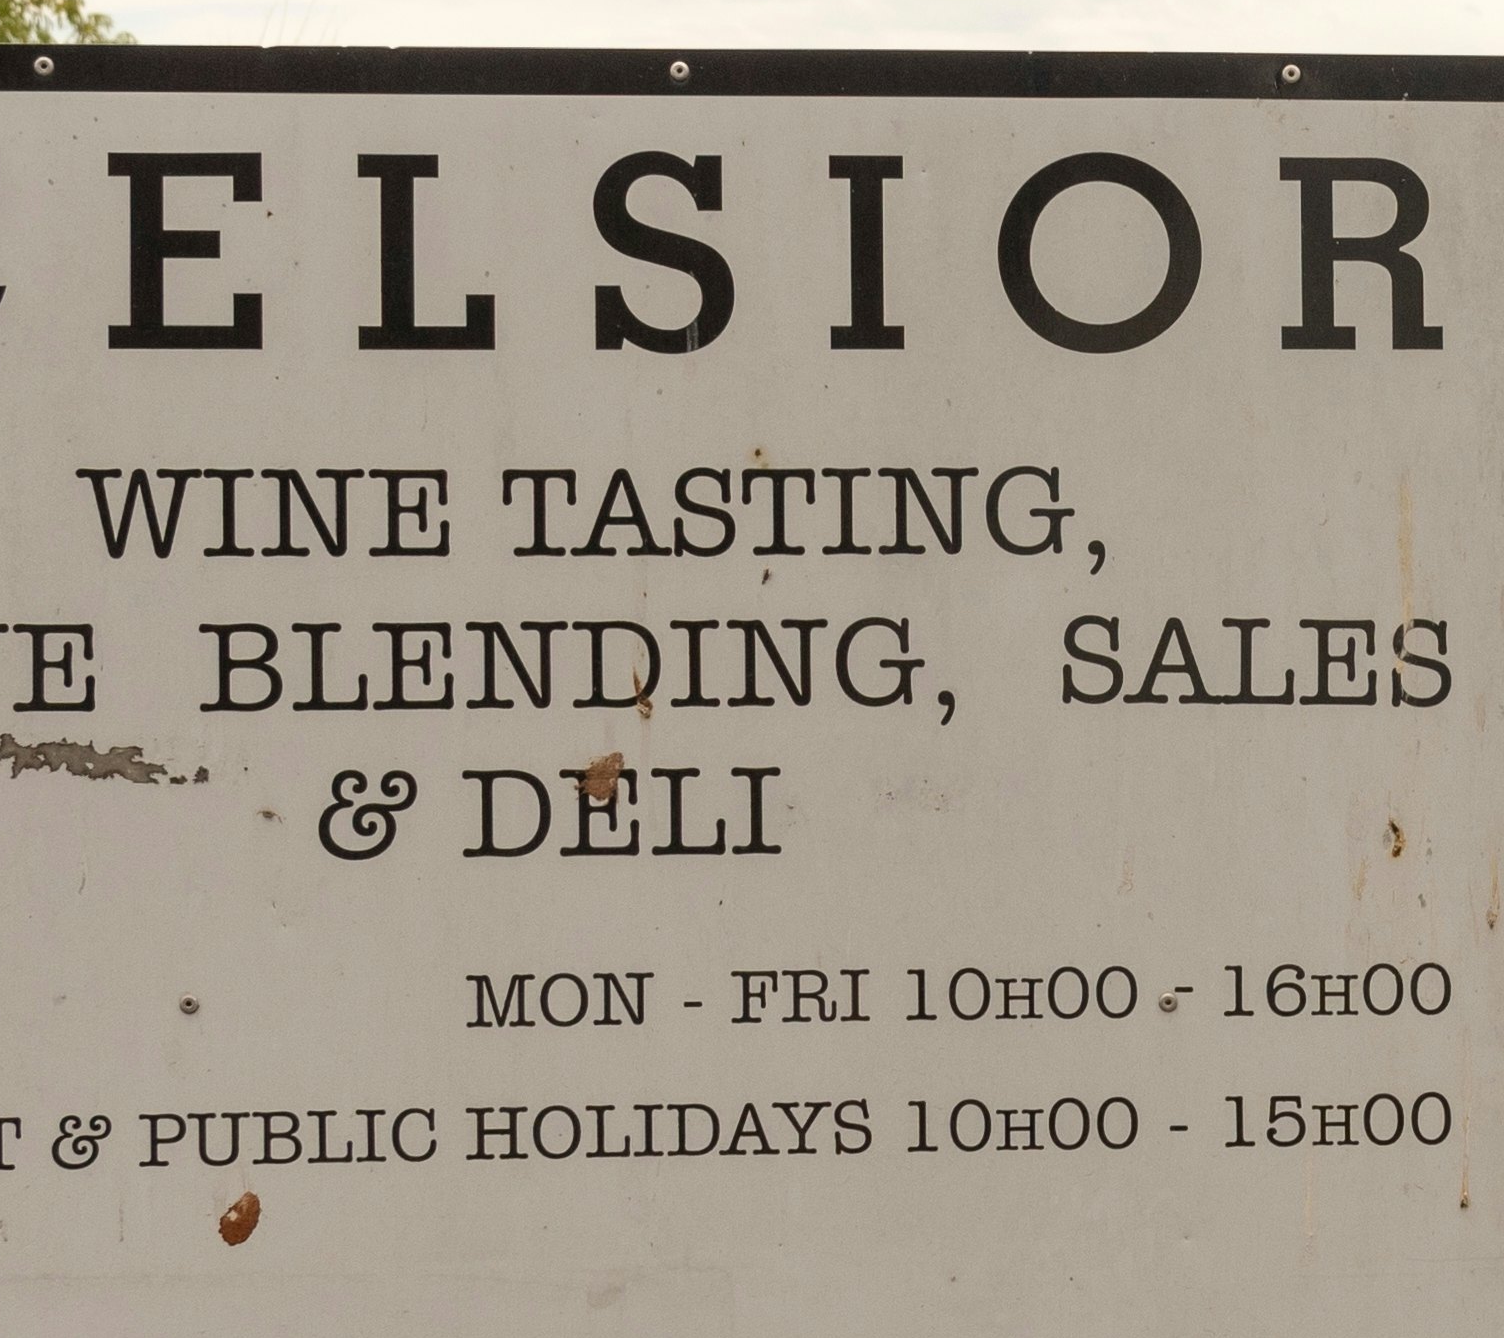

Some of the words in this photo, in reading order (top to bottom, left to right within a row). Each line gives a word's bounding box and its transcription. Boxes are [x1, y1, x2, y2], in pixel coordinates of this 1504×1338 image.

[76, 469, 449, 559] WINE
[502, 467, 1105, 575] TASTING,
[199, 617, 955, 725] BLENDING,
[1062, 615, 1451, 707] SALES
[319, 770, 417, 860] &
[462, 766, 781, 857] DELI
[466, 972, 654, 1028] MON
[731, 969, 870, 1023] FRI
[906, 966, 1137, 1021] 10H00
[1224, 963, 1451, 1017] 16H00
[52, 1115, 111, 1170] &
[139, 1108, 437, 1167] PUBLIC
[466, 1099, 872, 1160] HOLIDAYS
[908, 1097, 1138, 1152] 10H00
[1225, 1092, 1451, 1147] 15H00
